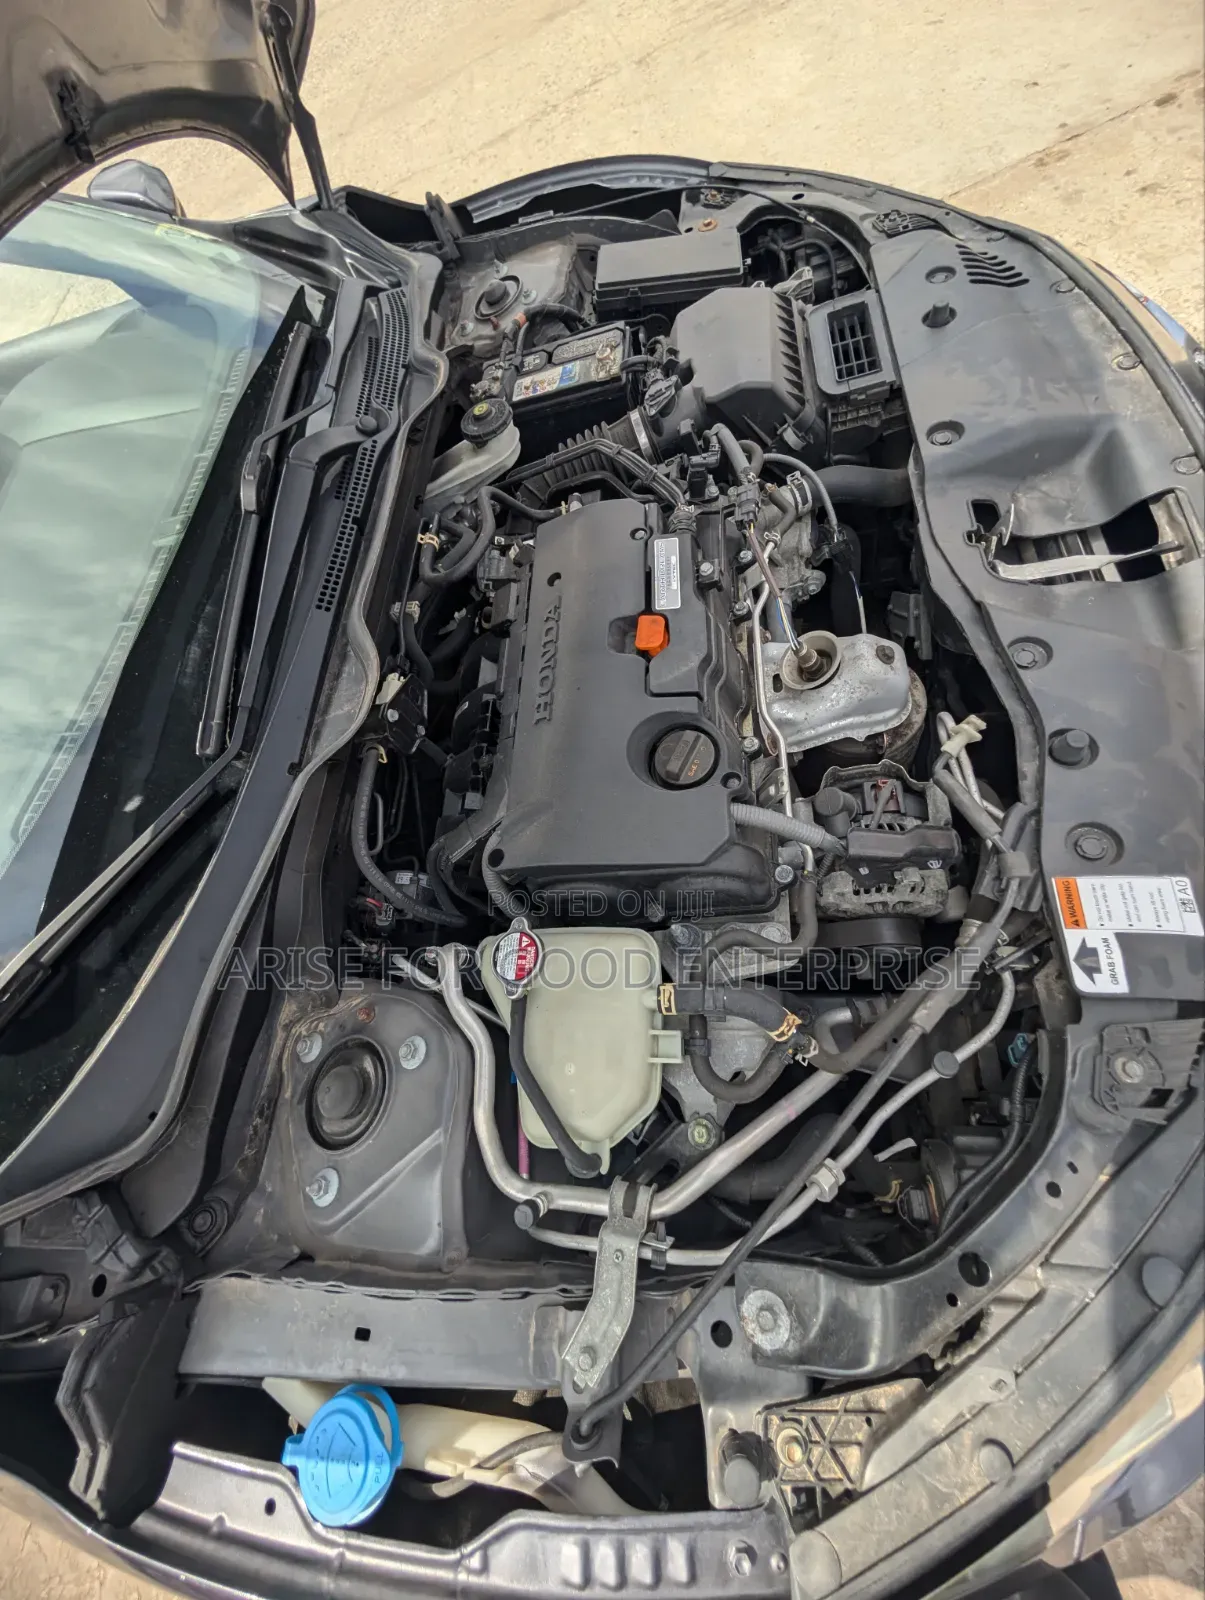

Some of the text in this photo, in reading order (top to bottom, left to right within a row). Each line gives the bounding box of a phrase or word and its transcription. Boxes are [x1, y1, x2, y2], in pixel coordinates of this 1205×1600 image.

[533, 596, 562, 725] HONDA
[1062, 880, 1078, 918] WARNING
[1175, 880, 1191, 896] A0
[1101, 937, 1120, 985] GRAB FOAM
[374, 1452, 384, 1484] PULL
